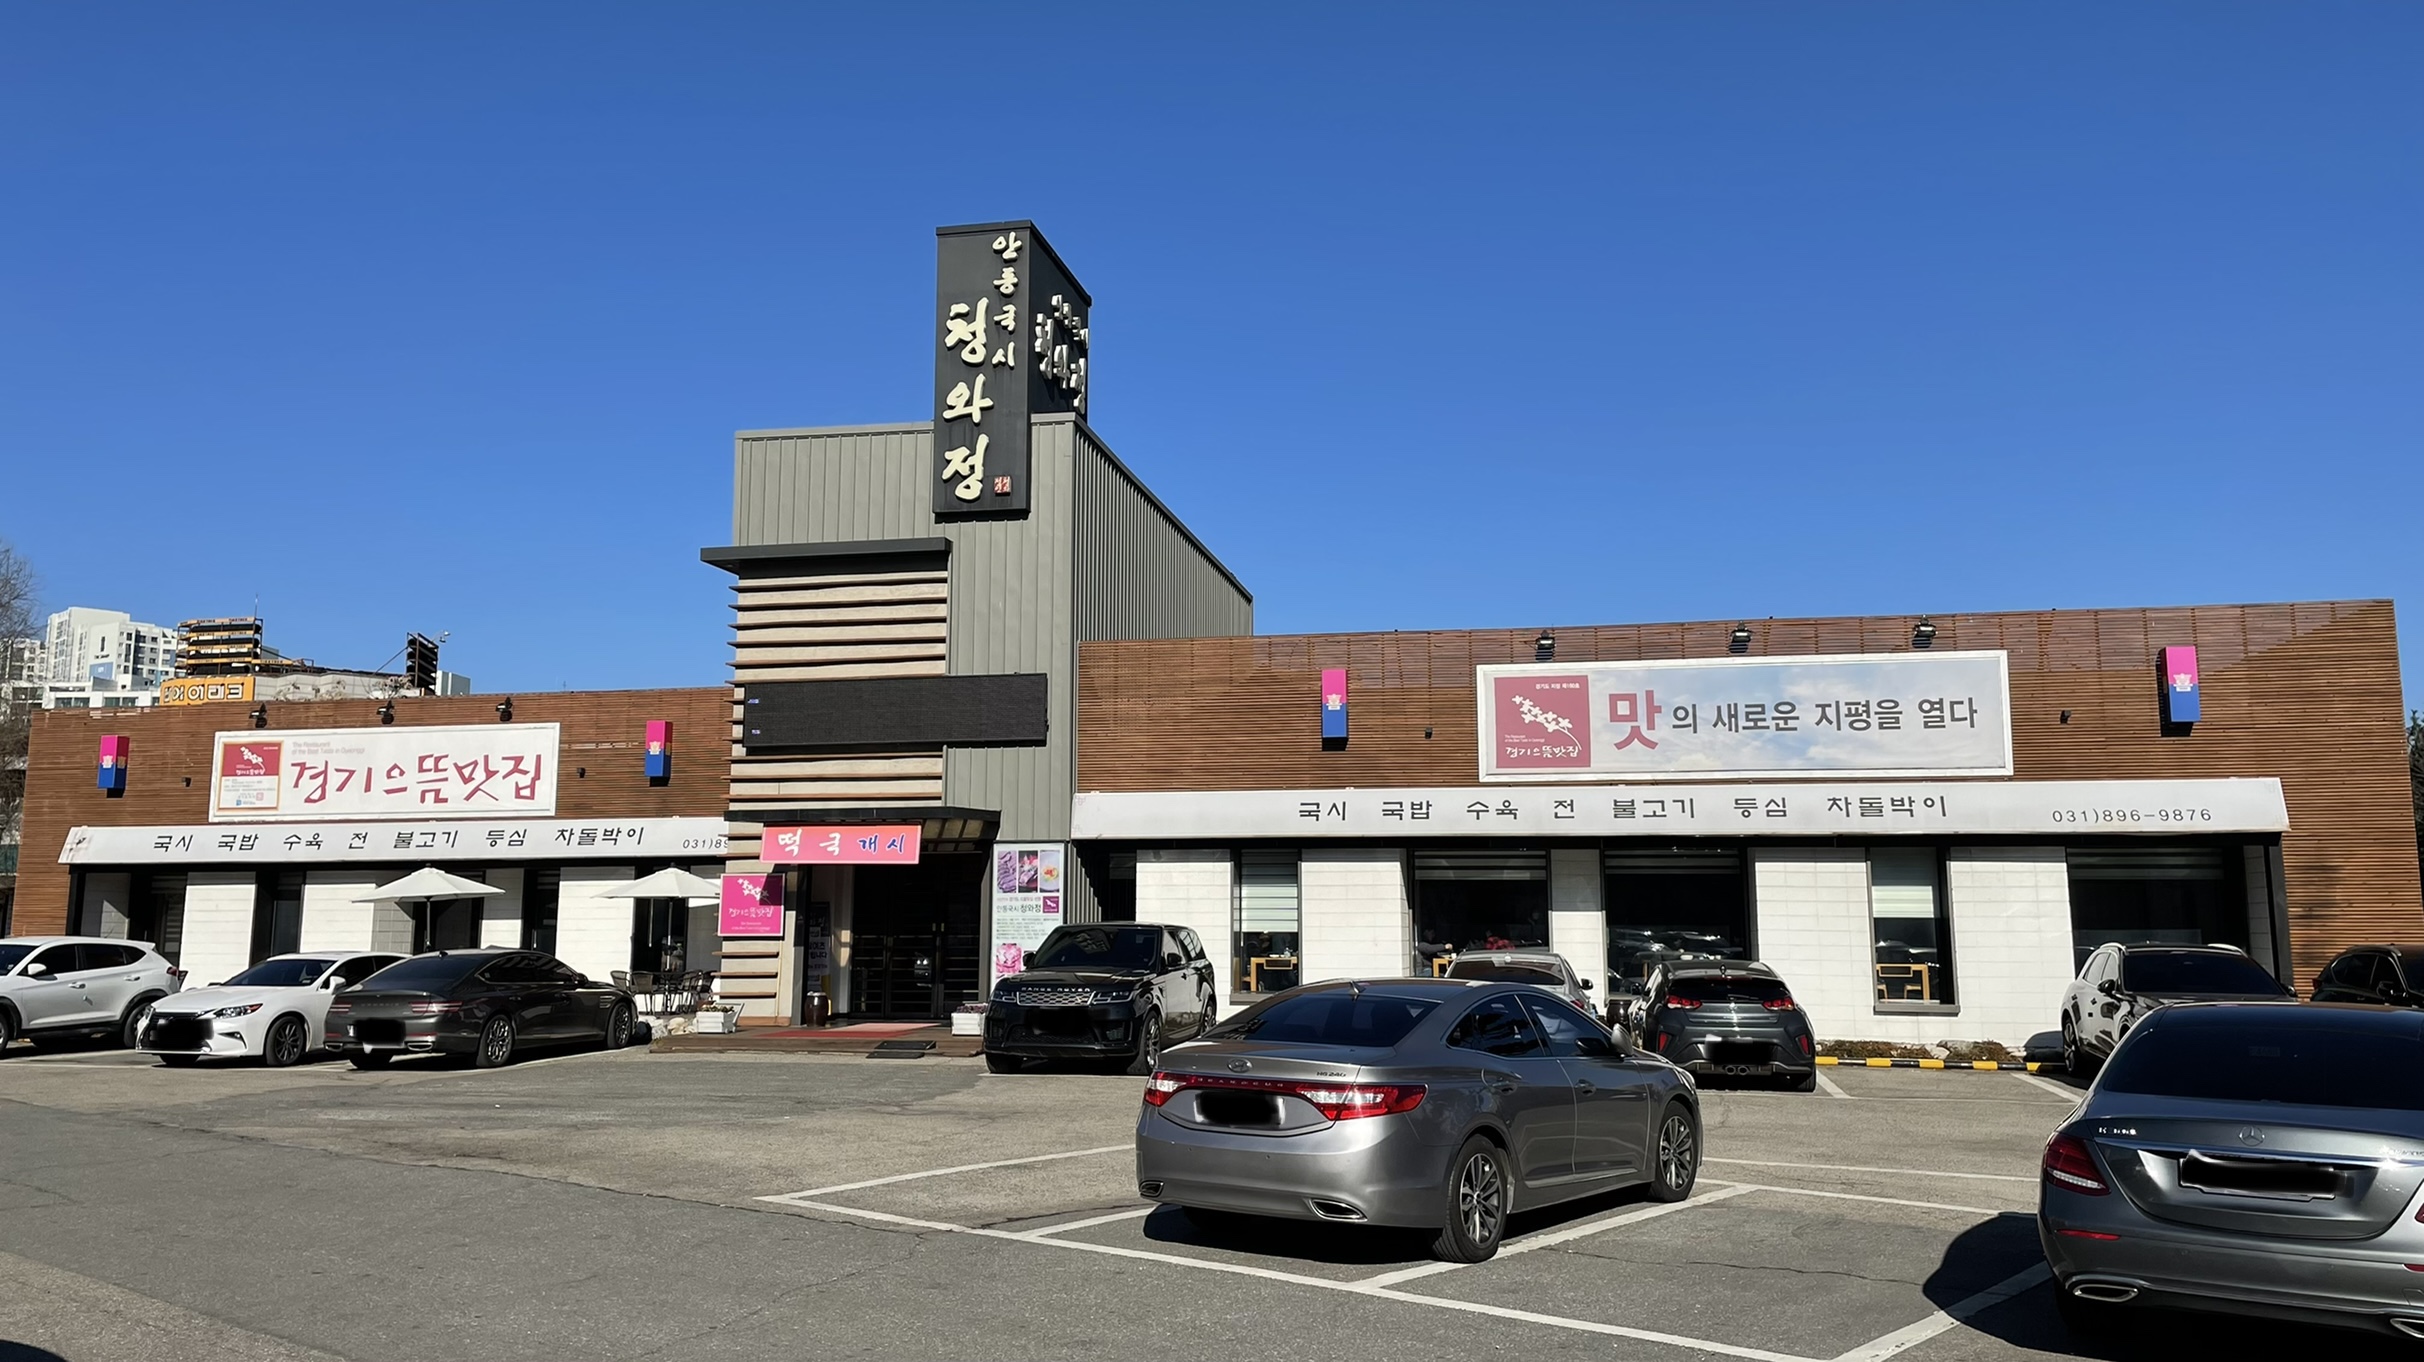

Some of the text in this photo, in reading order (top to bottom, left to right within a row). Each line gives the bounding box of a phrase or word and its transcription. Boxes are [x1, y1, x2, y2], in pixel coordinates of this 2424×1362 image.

[992, 231, 1023, 367] 안동국시
[941, 296, 995, 500] 청와정
[1712, 701, 1800, 733] 새로운
[1815, 699, 1903, 731] 지평을
[1918, 697, 1978, 729] 열다
[1505, 745, 1580, 758] 경기으뜸맛집
[291, 754, 542, 804] 경기으뜸맛집
[1299, 796, 1947, 821] 국시 국밥 수육 전 불고기 등심 차돌박이
[2052, 809, 2212, 823] 031)896-9876
[153, 827, 645, 852] 국시 국밥 수육 전 불고기 등심 차돌박이
